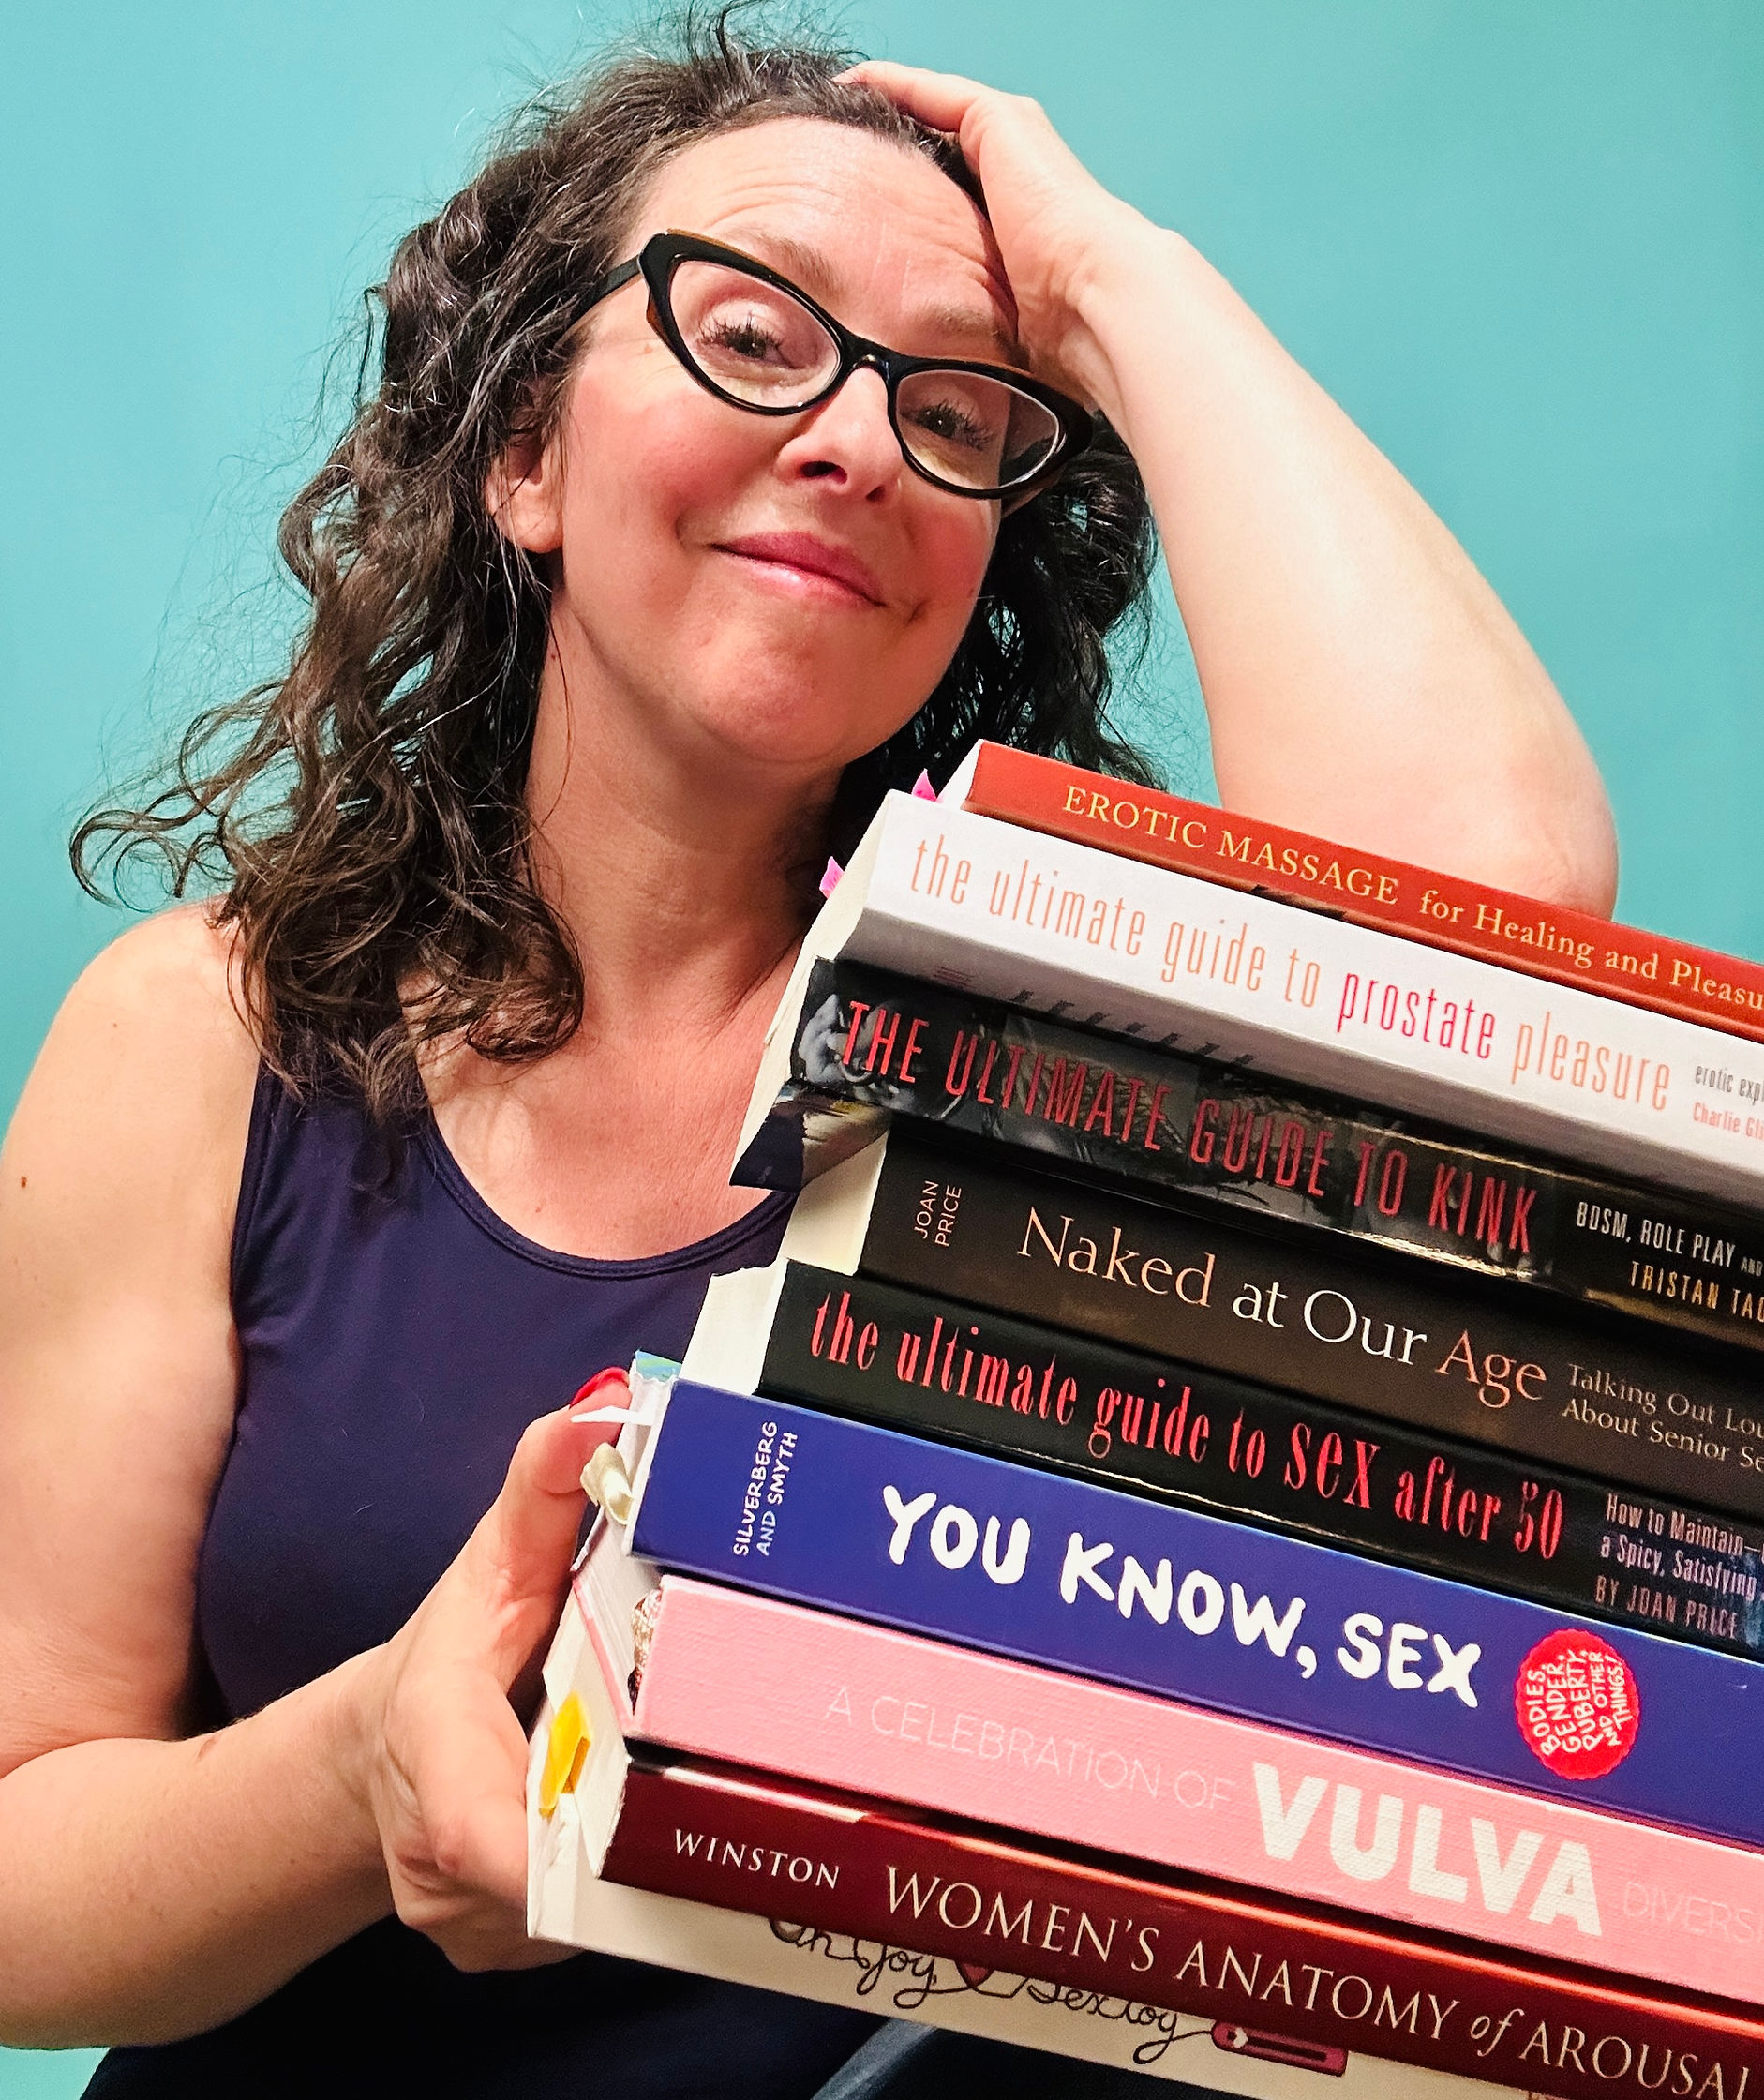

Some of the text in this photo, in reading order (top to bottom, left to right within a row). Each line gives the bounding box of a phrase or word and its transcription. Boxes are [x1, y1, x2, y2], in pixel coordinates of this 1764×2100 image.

[1062, 786, 1764, 1010] EROTIC MASSAGE for Healing and Pleasu
[910, 834, 1671, 1112] the ultimate guide to prostate pleasure
[1694, 1066, 1733, 1093] erotic
[842, 1000, 1537, 1253] THE ULTIMATE GUIDE TO KINK
[914, 1180, 939, 1239] JOAN
[934, 1184, 962, 1247] PRICE
[1576, 1201, 1763, 1277] BDSM, ROLE PLAY AND
[1017, 1207, 1547, 1409] Naked at Our Age
[1630, 1260, 1719, 1310] TRISTAN
[810, 1290, 878, 1371] the
[897, 1316, 1077, 1426] ultimate
[1087, 1377, 1209, 1463] guide
[1228, 1406, 1266, 1478] to
[1394, 1456, 1502, 1542] after
[1514, 1481, 1563, 1560] 50
[1562, 1398, 1640, 1437] About
[1650, 1419, 1730, 1461] Senior
[1568, 1363, 1656, 1415] Talking
[1667, 1393, 1714, 1424] Out
[733, 1421, 778, 1556] SILVERBERG
[755, 1432, 799, 1556] AND SMYTH
[1606, 1492, 1643, 1529] How
[1648, 1508, 1666, 1536] to
[882, 1484, 1482, 1708] YOU KNOW, SEX
[1595, 1575, 1739, 1639] BY JOAN PRICE
[1600, 1534, 1757, 1602] a Spicy, Satisfying
[1588, 1651, 1622, 1747] AND OTHER
[1605, 1654, 1634, 1730] THINGS!
[824, 1686, 852, 1724] A
[871, 1695, 1161, 1798] CELEBRATION
[1174, 1769, 1236, 1810] OF
[1252, 1761, 1603, 1937] VULVA
[674, 1828, 840, 1890] WINSTON
[886, 1865, 1160, 1972] WOMEN'S
[1175, 1940, 1460, 2041] ANATOMY
[1471, 2009, 1526, 2057] of
